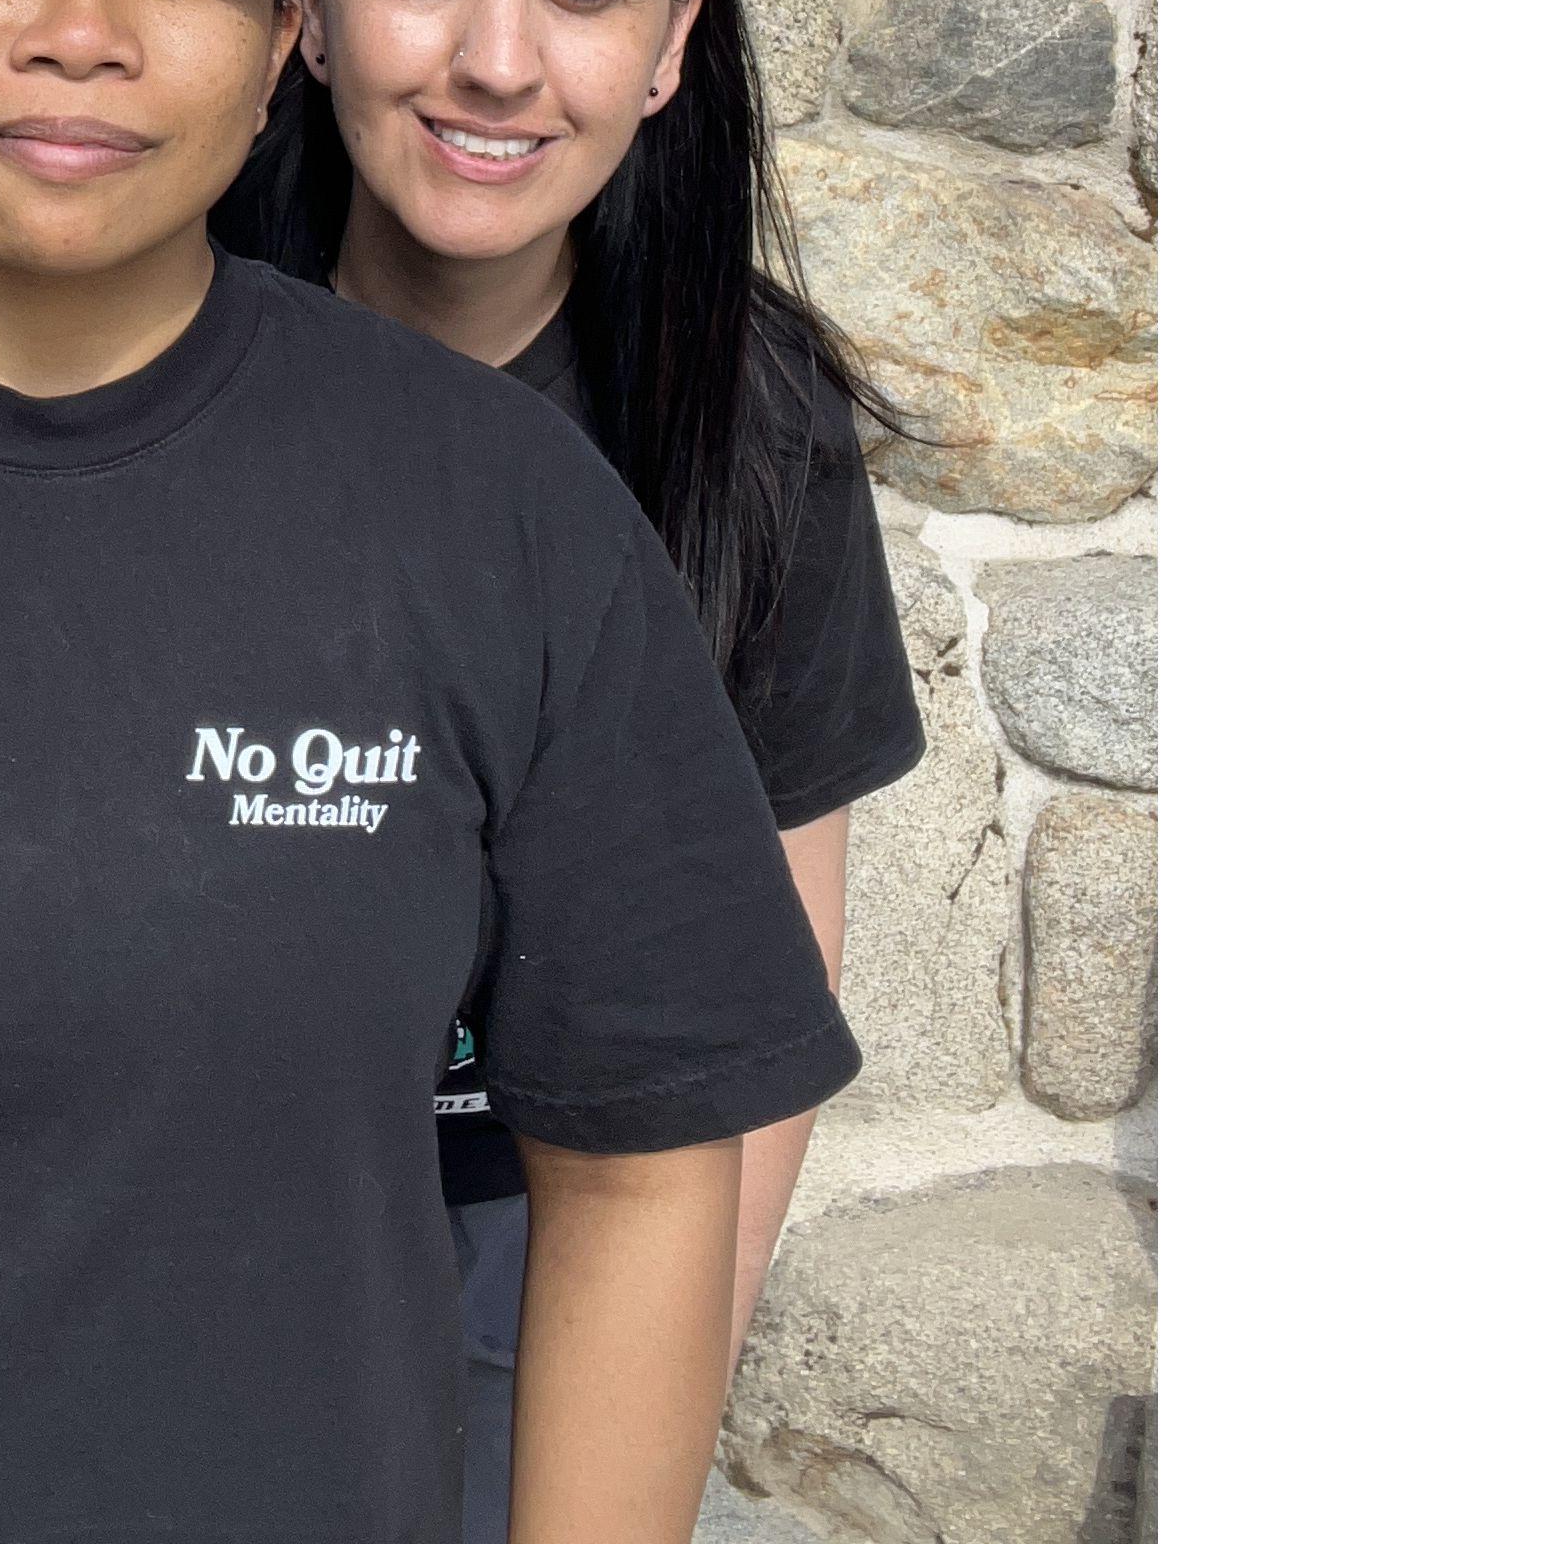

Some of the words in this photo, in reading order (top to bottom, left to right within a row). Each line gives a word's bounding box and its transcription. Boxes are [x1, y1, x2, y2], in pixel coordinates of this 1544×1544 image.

[185, 727, 277, 784] No
[290, 728, 422, 795] Quit
[228, 792, 389, 835] Mentality
